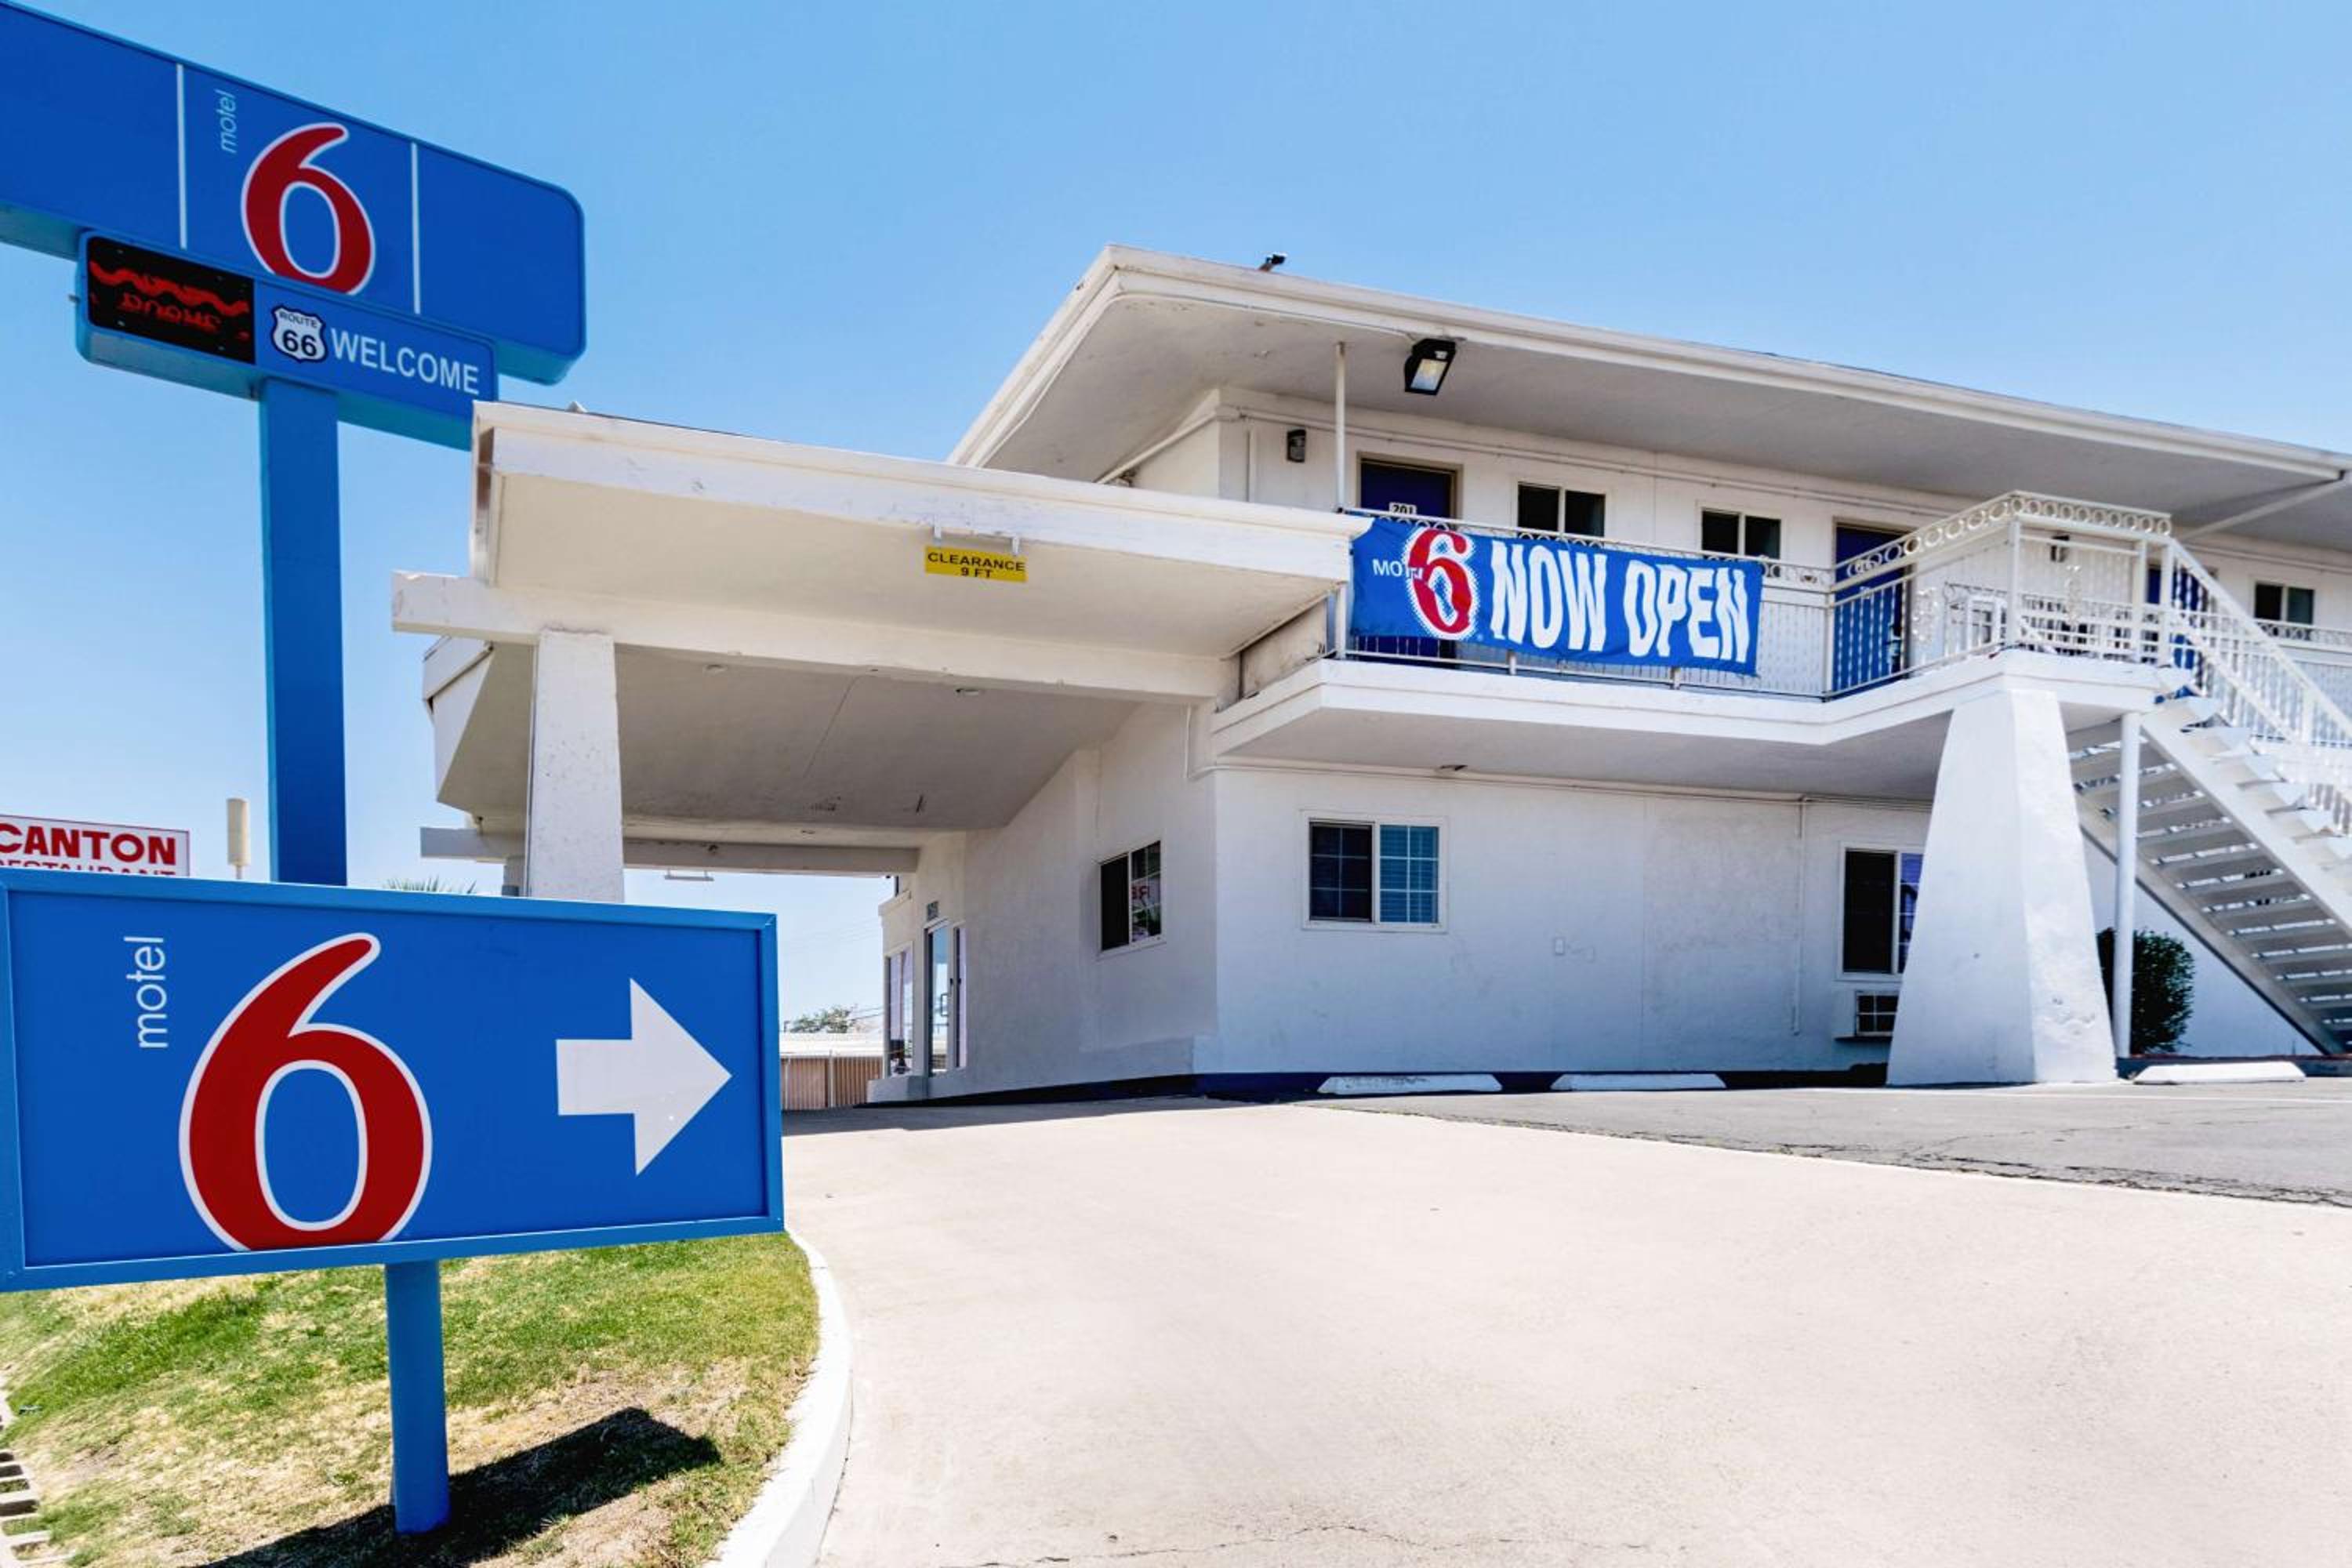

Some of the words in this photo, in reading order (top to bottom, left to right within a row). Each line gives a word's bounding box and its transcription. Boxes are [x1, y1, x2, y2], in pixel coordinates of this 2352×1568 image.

[215, 89, 238, 154] motel
[240, 122, 376, 296] 6
[280, 311, 318, 328] ROUTE
[283, 330, 317, 357] 66
[331, 327, 479, 395] WELCOME
[927, 552, 1025, 572] CLEARANCE
[960, 567, 969, 576] 9
[975, 568, 993, 579] FT
[1406, 527, 1472, 638] 6
[1491, 540, 1607, 652] NOW
[1624, 559, 1748, 663] OPEN
[0, 824, 176, 866] CANTON
[123, 936, 168, 1047] motel
[179, 932, 433, 1251] 6
